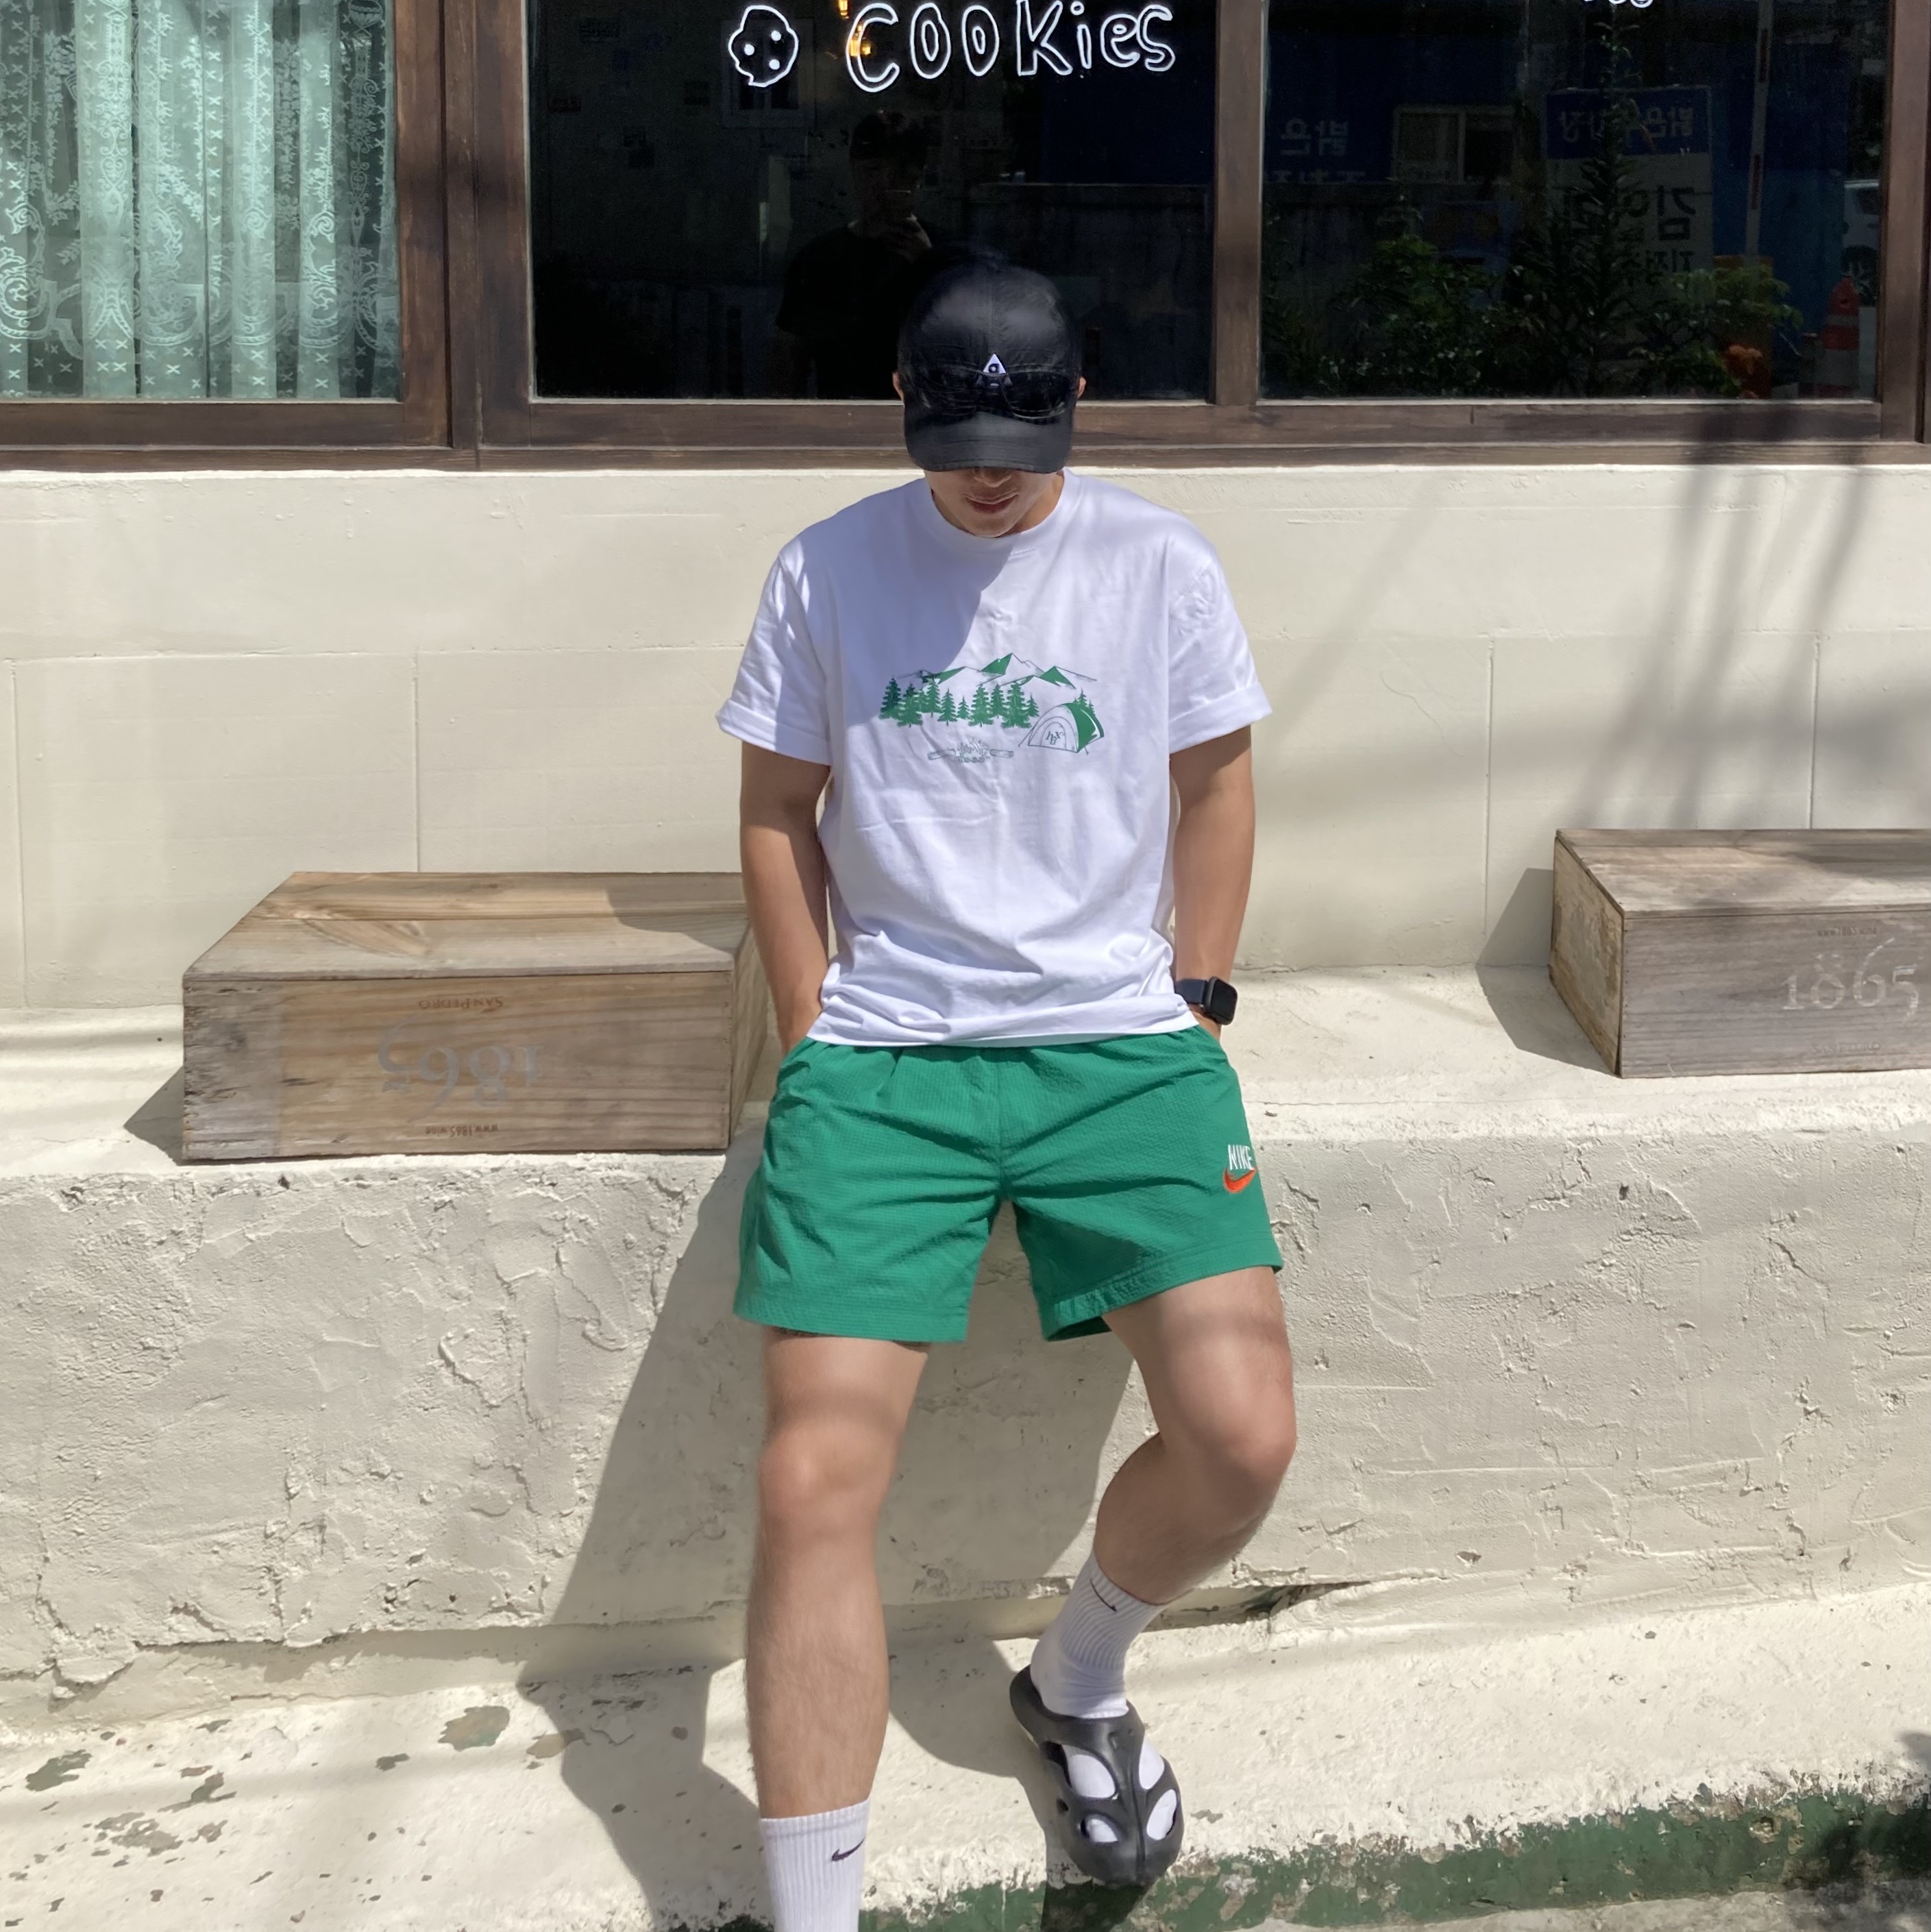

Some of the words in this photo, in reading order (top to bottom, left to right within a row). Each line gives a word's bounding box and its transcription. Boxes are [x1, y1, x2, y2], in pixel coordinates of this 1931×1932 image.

[1781, 938, 1919, 1020] 1865
[378, 1012, 545, 1123] 1865
[1227, 1144, 1255, 1171] NIKE
